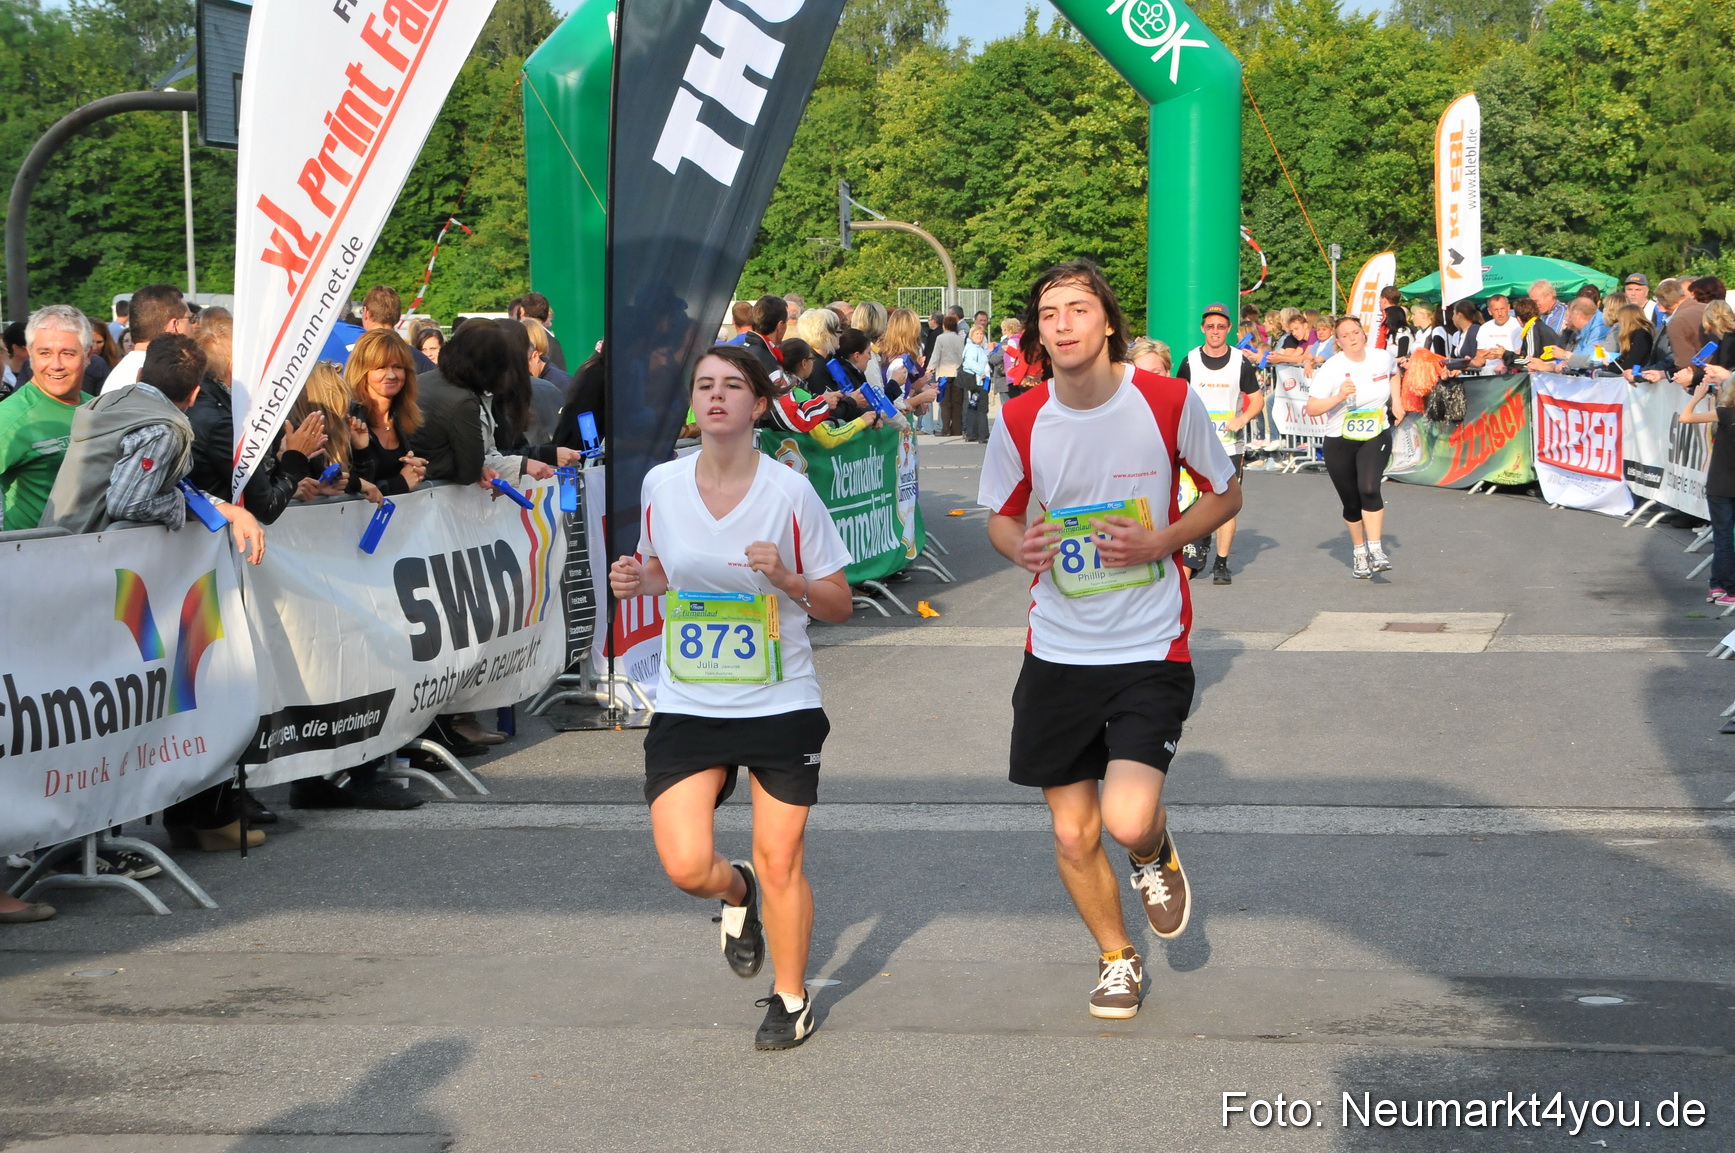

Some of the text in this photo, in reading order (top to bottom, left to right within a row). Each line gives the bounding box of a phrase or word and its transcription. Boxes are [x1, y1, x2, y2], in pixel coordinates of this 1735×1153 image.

[1106, 0, 1210, 85] OK
[256, 0, 440, 298] XL Print Fa
[1465, 128, 1478, 210] www.klebl.de
[1346, 420, 1375, 433] 632
[1542, 403, 1618, 475] MEIER
[830, 445, 885, 500] Neumarkter
[1112, 470, 1157, 479] www.auctores.de
[1060, 533, 1114, 574] 87
[1078, 571, 1106, 582] Phillip
[393, 539, 525, 662] swn
[680, 623, 756, 660] 873
[697, 661, 719, 669] Julia
[302, 719, 328, 738] die
[331, 709, 381, 736] verbinden
[44, 756, 110, 798] Druck
[136, 735, 207, 771] Medien
